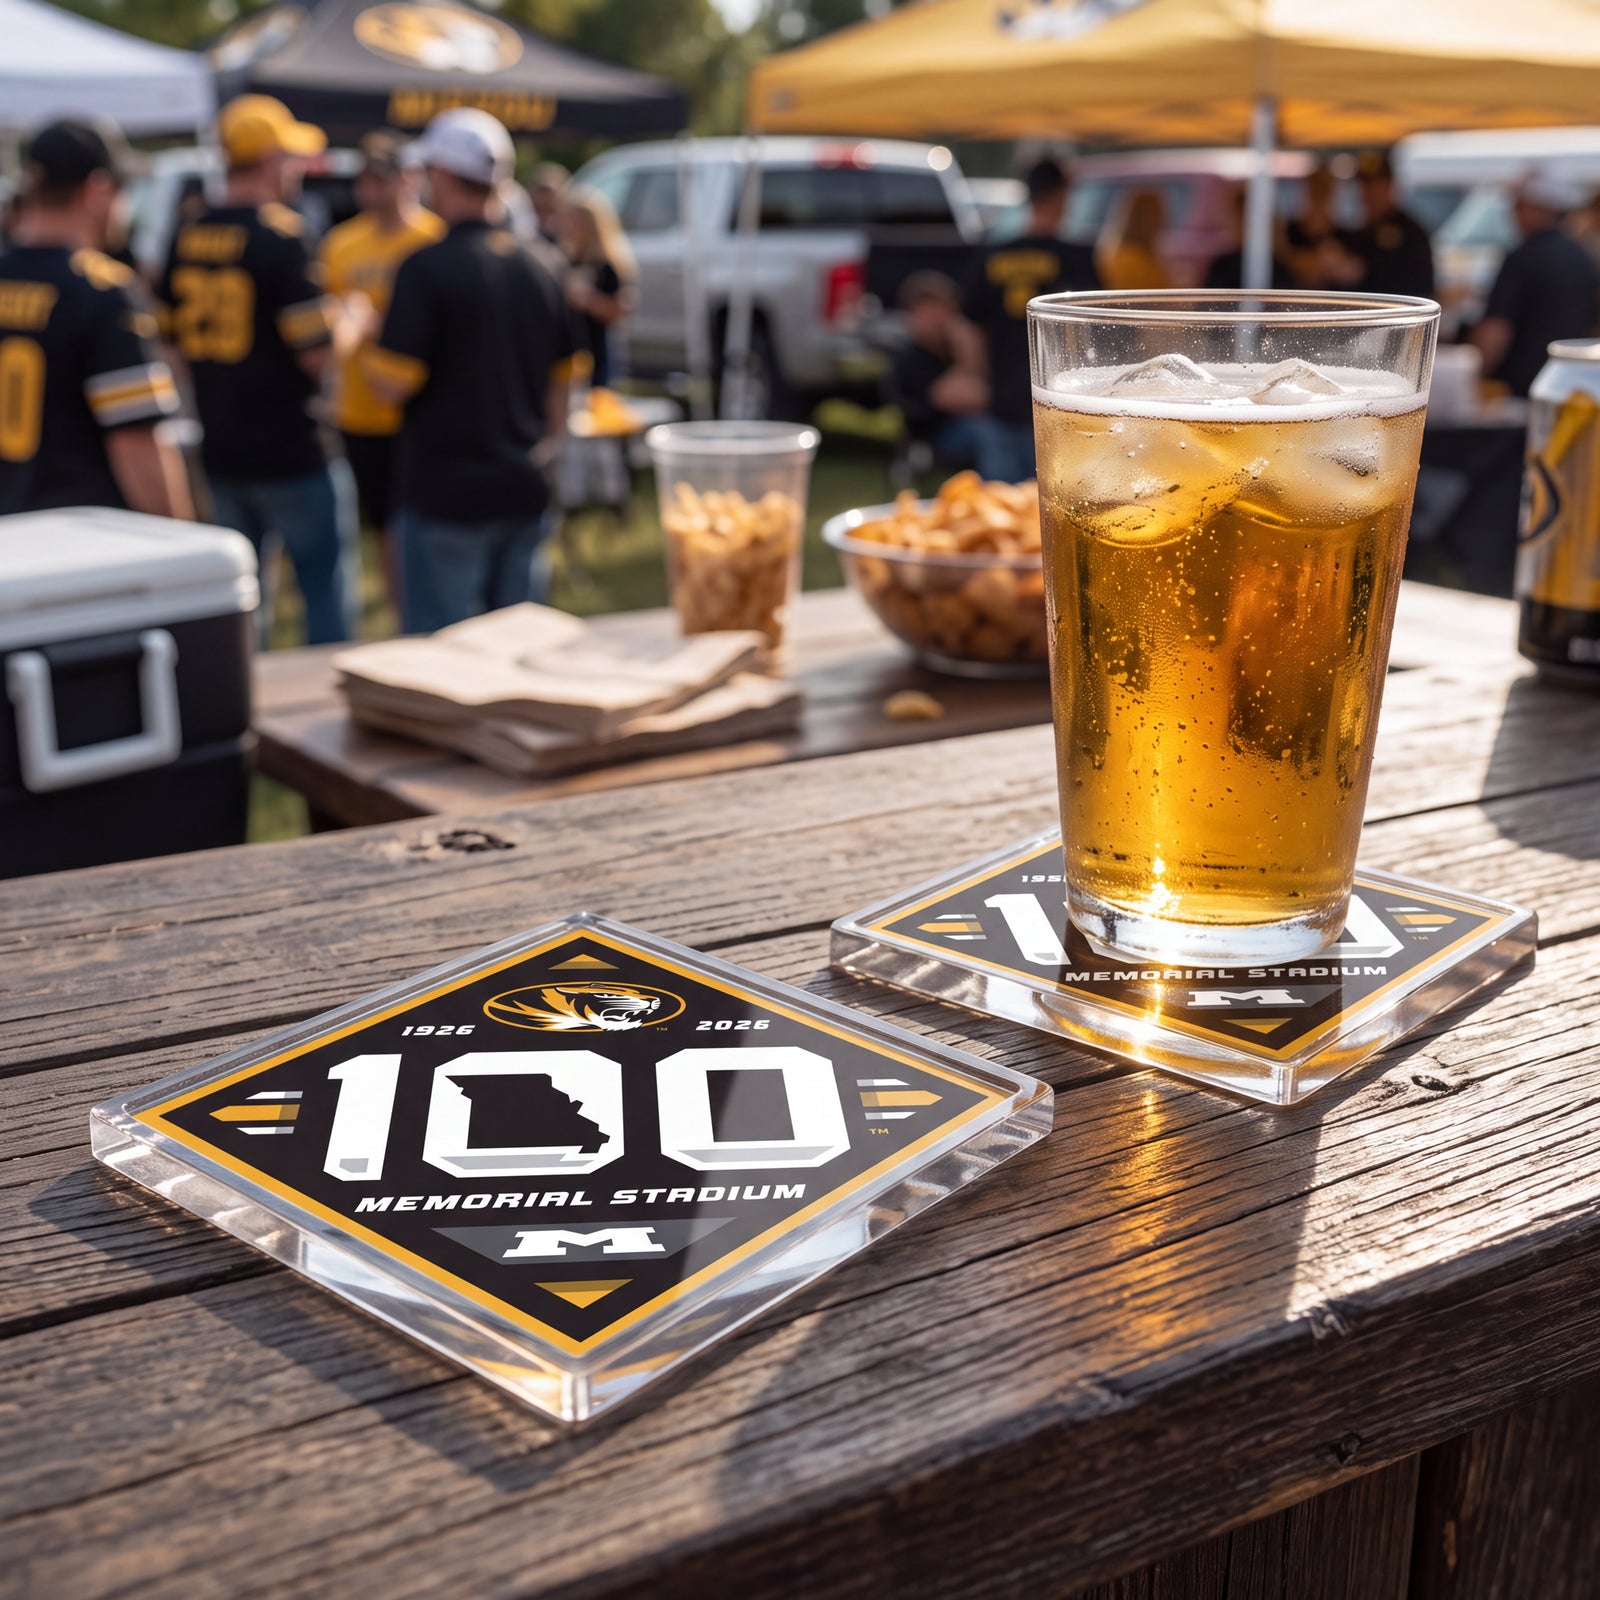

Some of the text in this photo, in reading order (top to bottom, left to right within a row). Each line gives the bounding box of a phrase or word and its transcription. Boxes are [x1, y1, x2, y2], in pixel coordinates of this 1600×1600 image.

[1065, 969, 1234, 981] MEMORIAL
[1248, 966, 1387, 978] STADIUM
[1187, 989, 1306, 1007] M
[401, 1024, 475, 1037] 1926
[695, 1019, 770, 1031] 2026
[323, 1046, 851, 1181] 100
[354, 1191, 593, 1213] MEMORIAL
[609, 1184, 806, 1205] STADIUM
[502, 1226, 666, 1258] M
